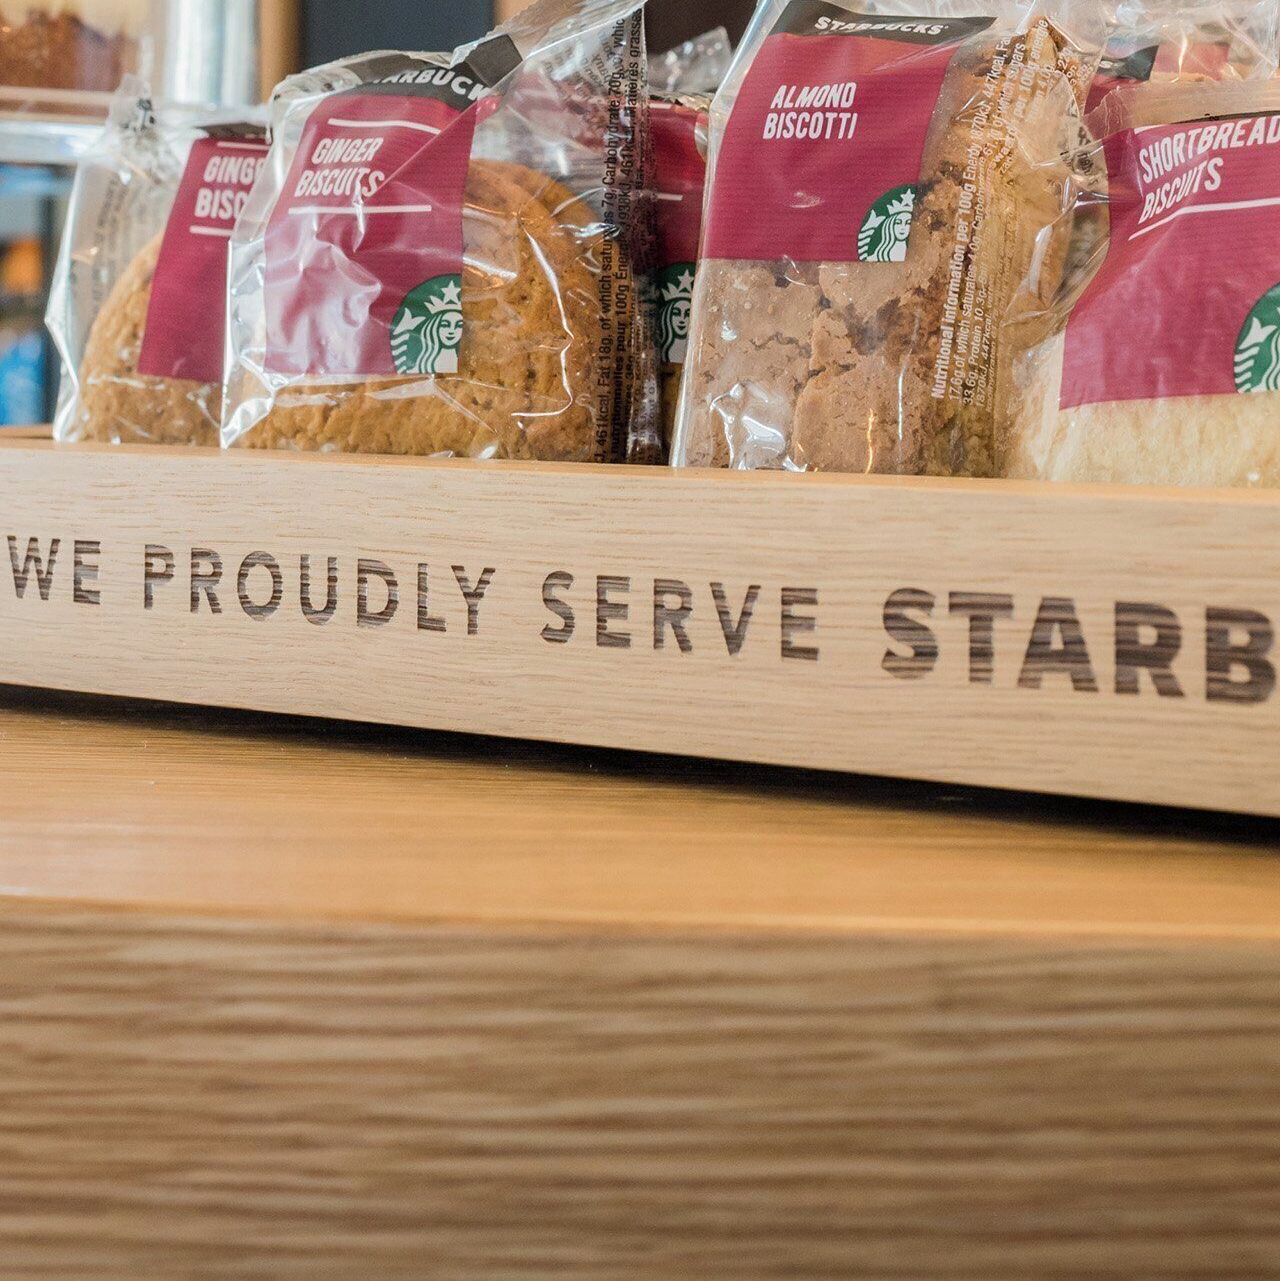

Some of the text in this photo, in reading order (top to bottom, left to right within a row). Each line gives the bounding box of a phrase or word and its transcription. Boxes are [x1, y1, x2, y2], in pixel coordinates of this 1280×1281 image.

[769, 81, 858, 109] ALMOND
[762, 112, 859, 140] BISCOTTI
[311, 137, 385, 165] GINGER
[602, 100, 620, 184] Carbohydrate
[294, 167, 385, 198] BISCUITS
[1137, 156, 1224, 225] BISCUITS
[959, 183, 975, 215] 100g
[954, 220, 968, 240] per
[597, 275, 612, 312] which
[942, 244, 964, 322] information
[614, 285, 629, 316] 100g
[598, 317, 610, 328] of
[954, 320, 969, 352] which
[968, 326, 982, 364] Protein
[598, 366, 610, 385] Fat
[931, 326, 953, 398] Nutritional
[952, 355, 965, 367] of
[6, 534, 102, 606] WE
[143, 543, 497, 636] PROUDLY
[539, 569, 822, 661] SERVE
